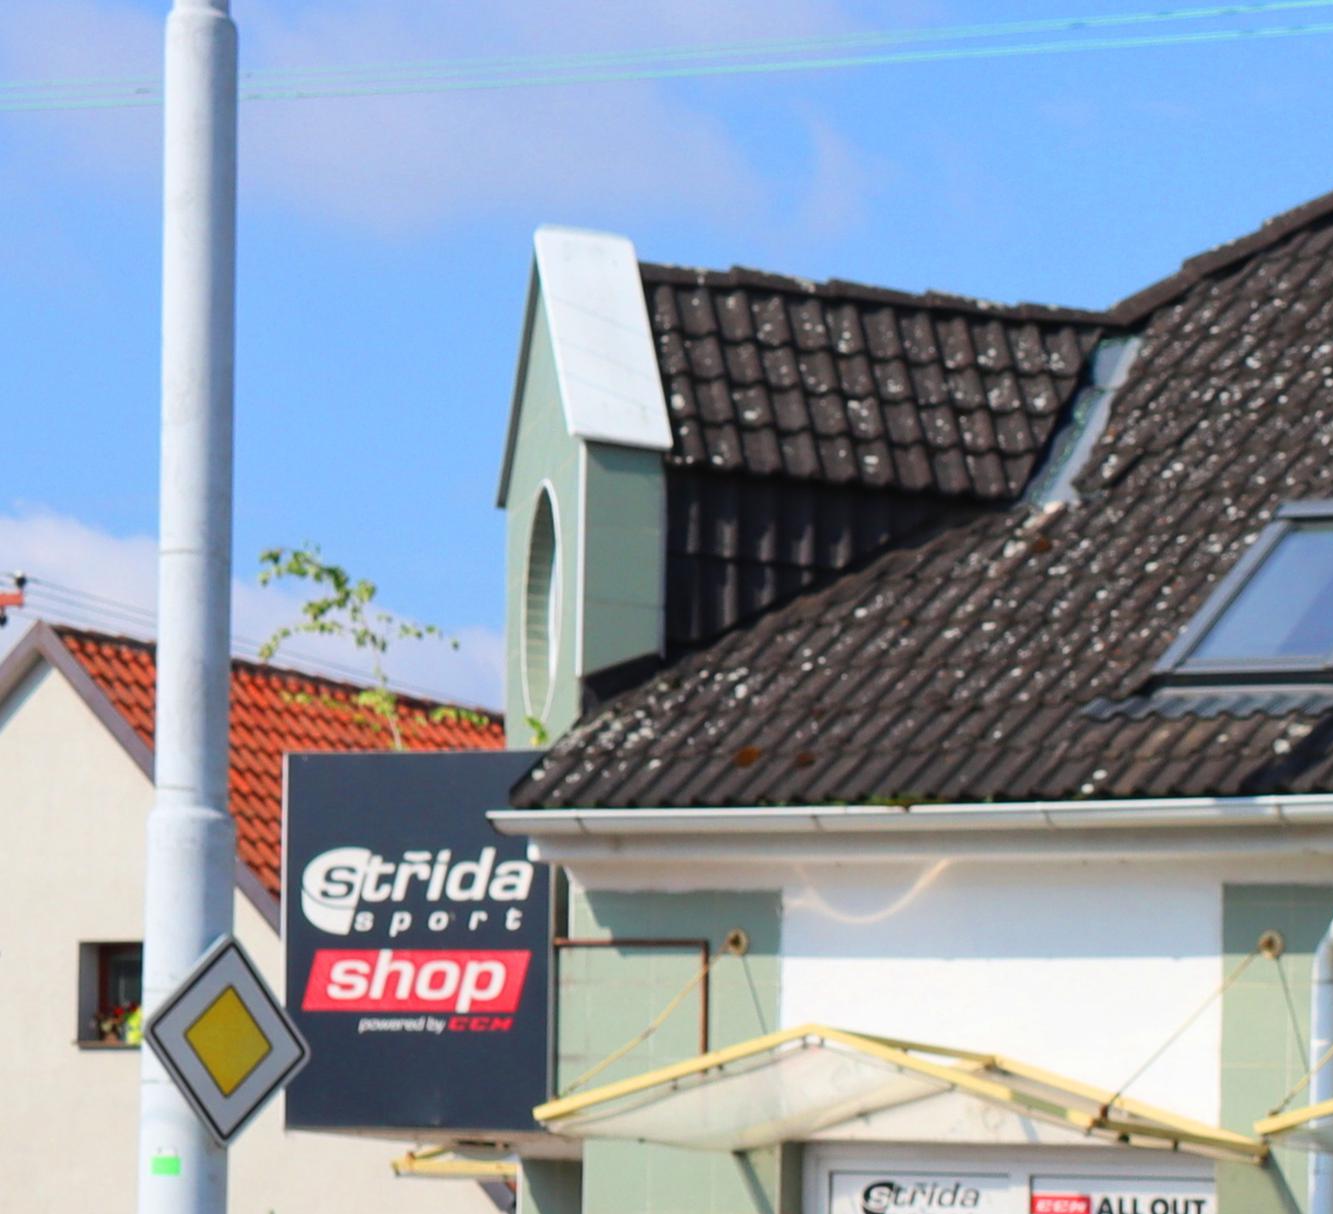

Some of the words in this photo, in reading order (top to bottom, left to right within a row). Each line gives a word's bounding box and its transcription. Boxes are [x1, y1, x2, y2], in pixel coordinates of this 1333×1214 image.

[354, 906, 523, 938] sport
[326, 948, 507, 1014] shop
[358, 1017, 424, 1034] powered
[426, 1017, 446, 1034] by
